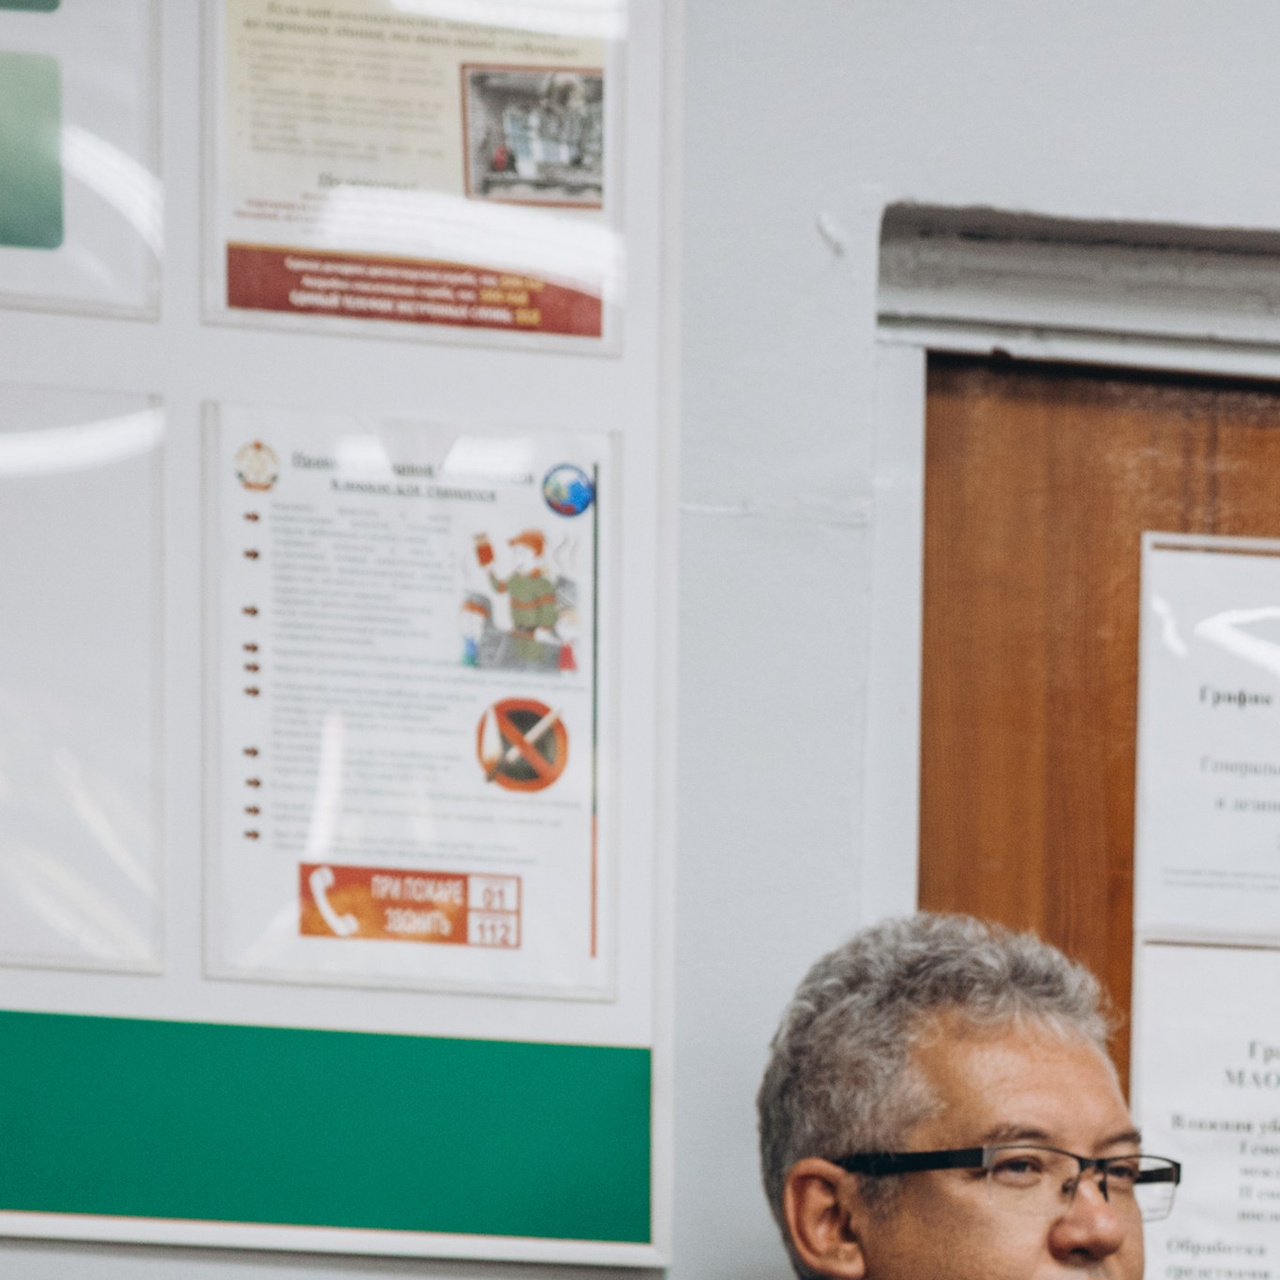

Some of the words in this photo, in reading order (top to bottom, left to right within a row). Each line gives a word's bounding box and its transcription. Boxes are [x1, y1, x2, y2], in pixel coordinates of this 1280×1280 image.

[1199, 686, 1272, 710] График
[371, 874, 401, 900] ПРИ
[403, 877, 464, 904] ПОЖАРЕ
[482, 888, 504, 908] 01
[384, 908, 452, 935] ЗВОНИТЬ
[478, 922, 509, 945] 112
[1170, 1113, 1253, 1134] Влажная
[1165, 1237, 1267, 1261] Обработка
